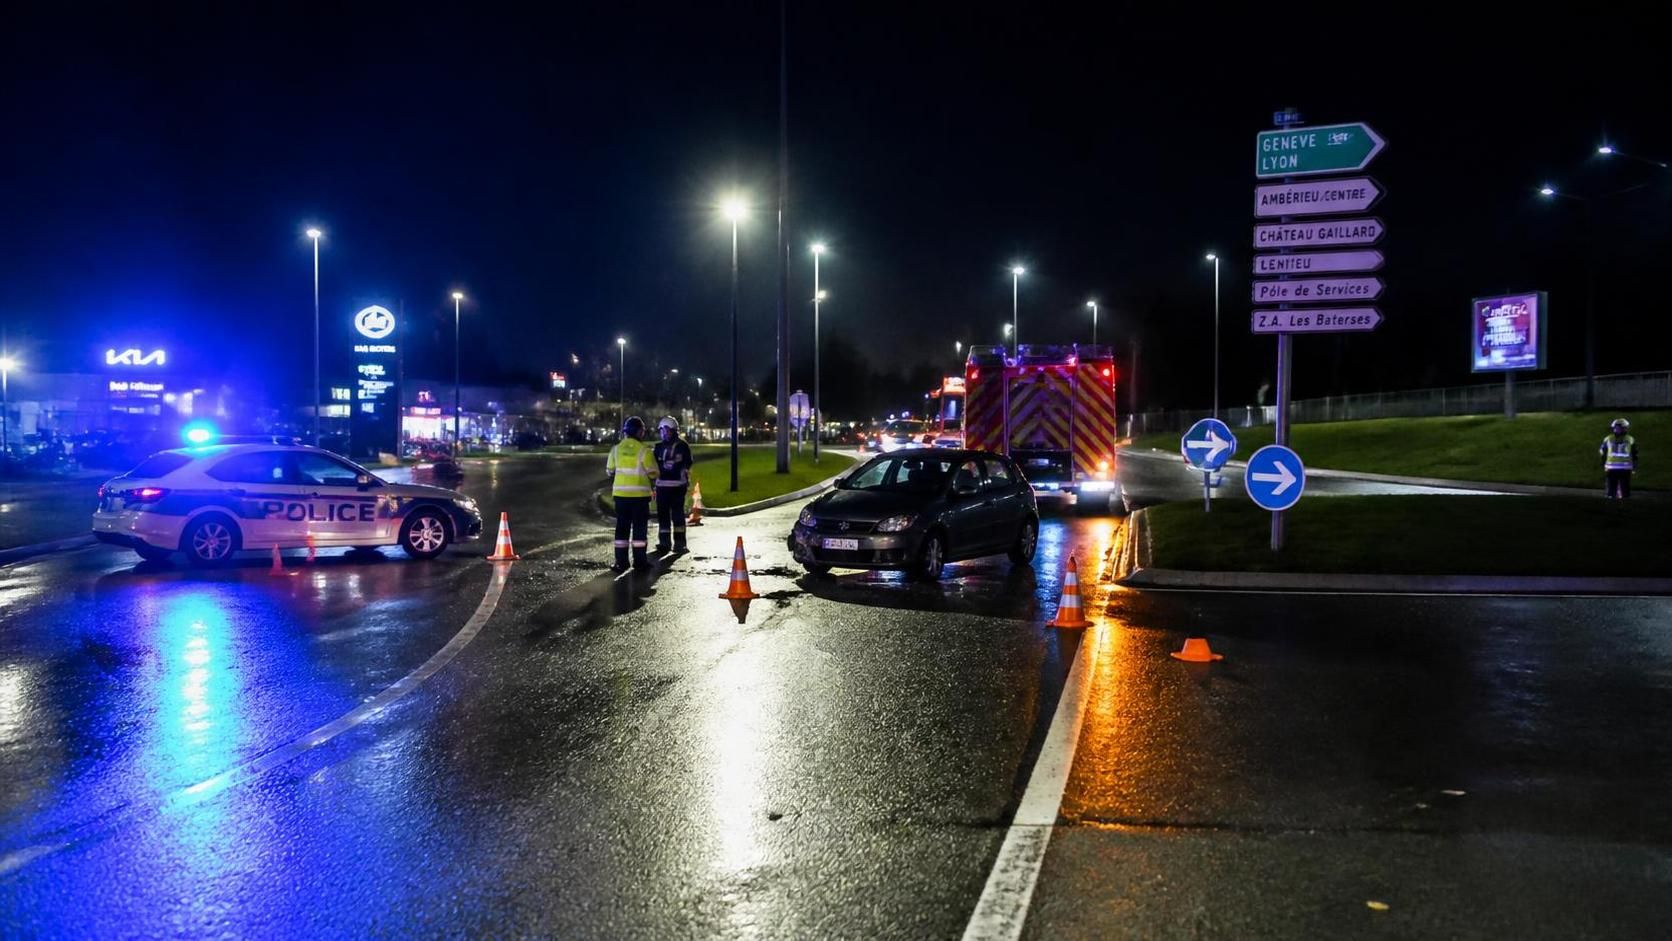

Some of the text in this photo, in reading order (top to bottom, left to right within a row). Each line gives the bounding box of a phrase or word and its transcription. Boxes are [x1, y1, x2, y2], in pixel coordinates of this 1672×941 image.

[1262, 154, 1298, 170] LYON
[1318, 226, 1376, 239] GAILLARD
[1295, 284, 1310, 296] de
[1316, 282, 1369, 296] Services
[1258, 314, 1371, 327] Z.A. Les Baterses
[106, 349, 166, 365] KIA
[263, 501, 376, 521] POLICE
